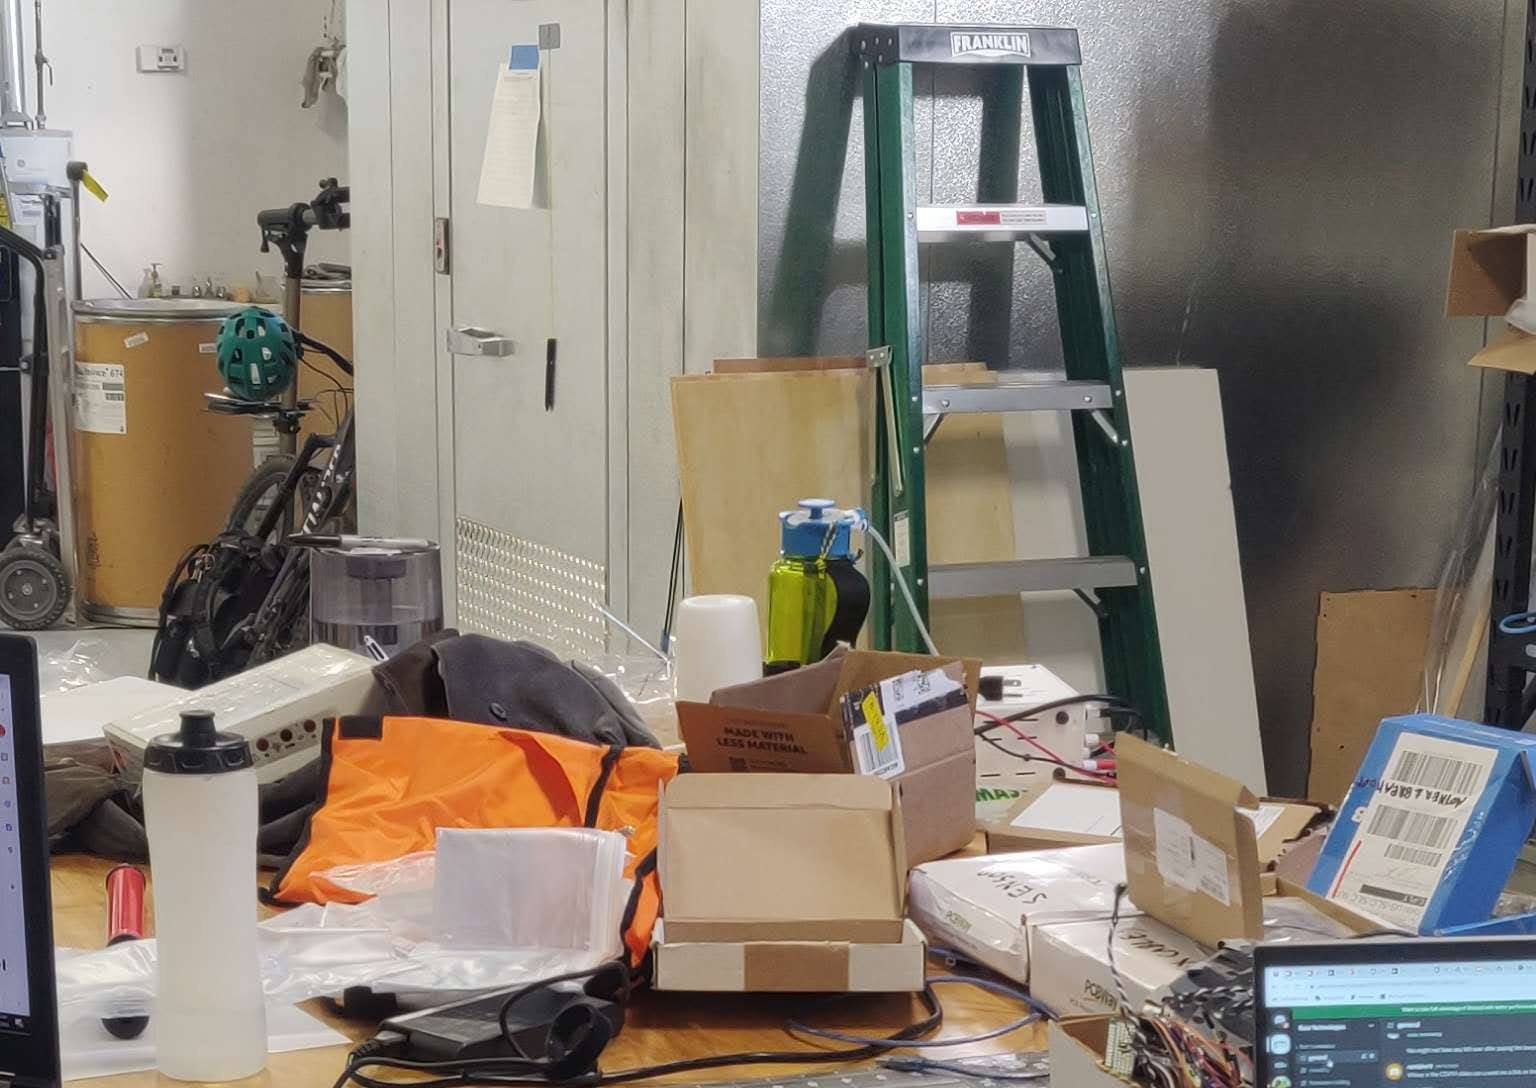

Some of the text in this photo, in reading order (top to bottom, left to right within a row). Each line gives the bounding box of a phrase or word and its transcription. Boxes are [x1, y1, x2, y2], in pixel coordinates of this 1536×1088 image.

[954, 34, 1027, 53] FRANKLIN
[724, 727, 794, 743] MADE WITH
[717, 738, 808, 755] LESS MATERIAL
